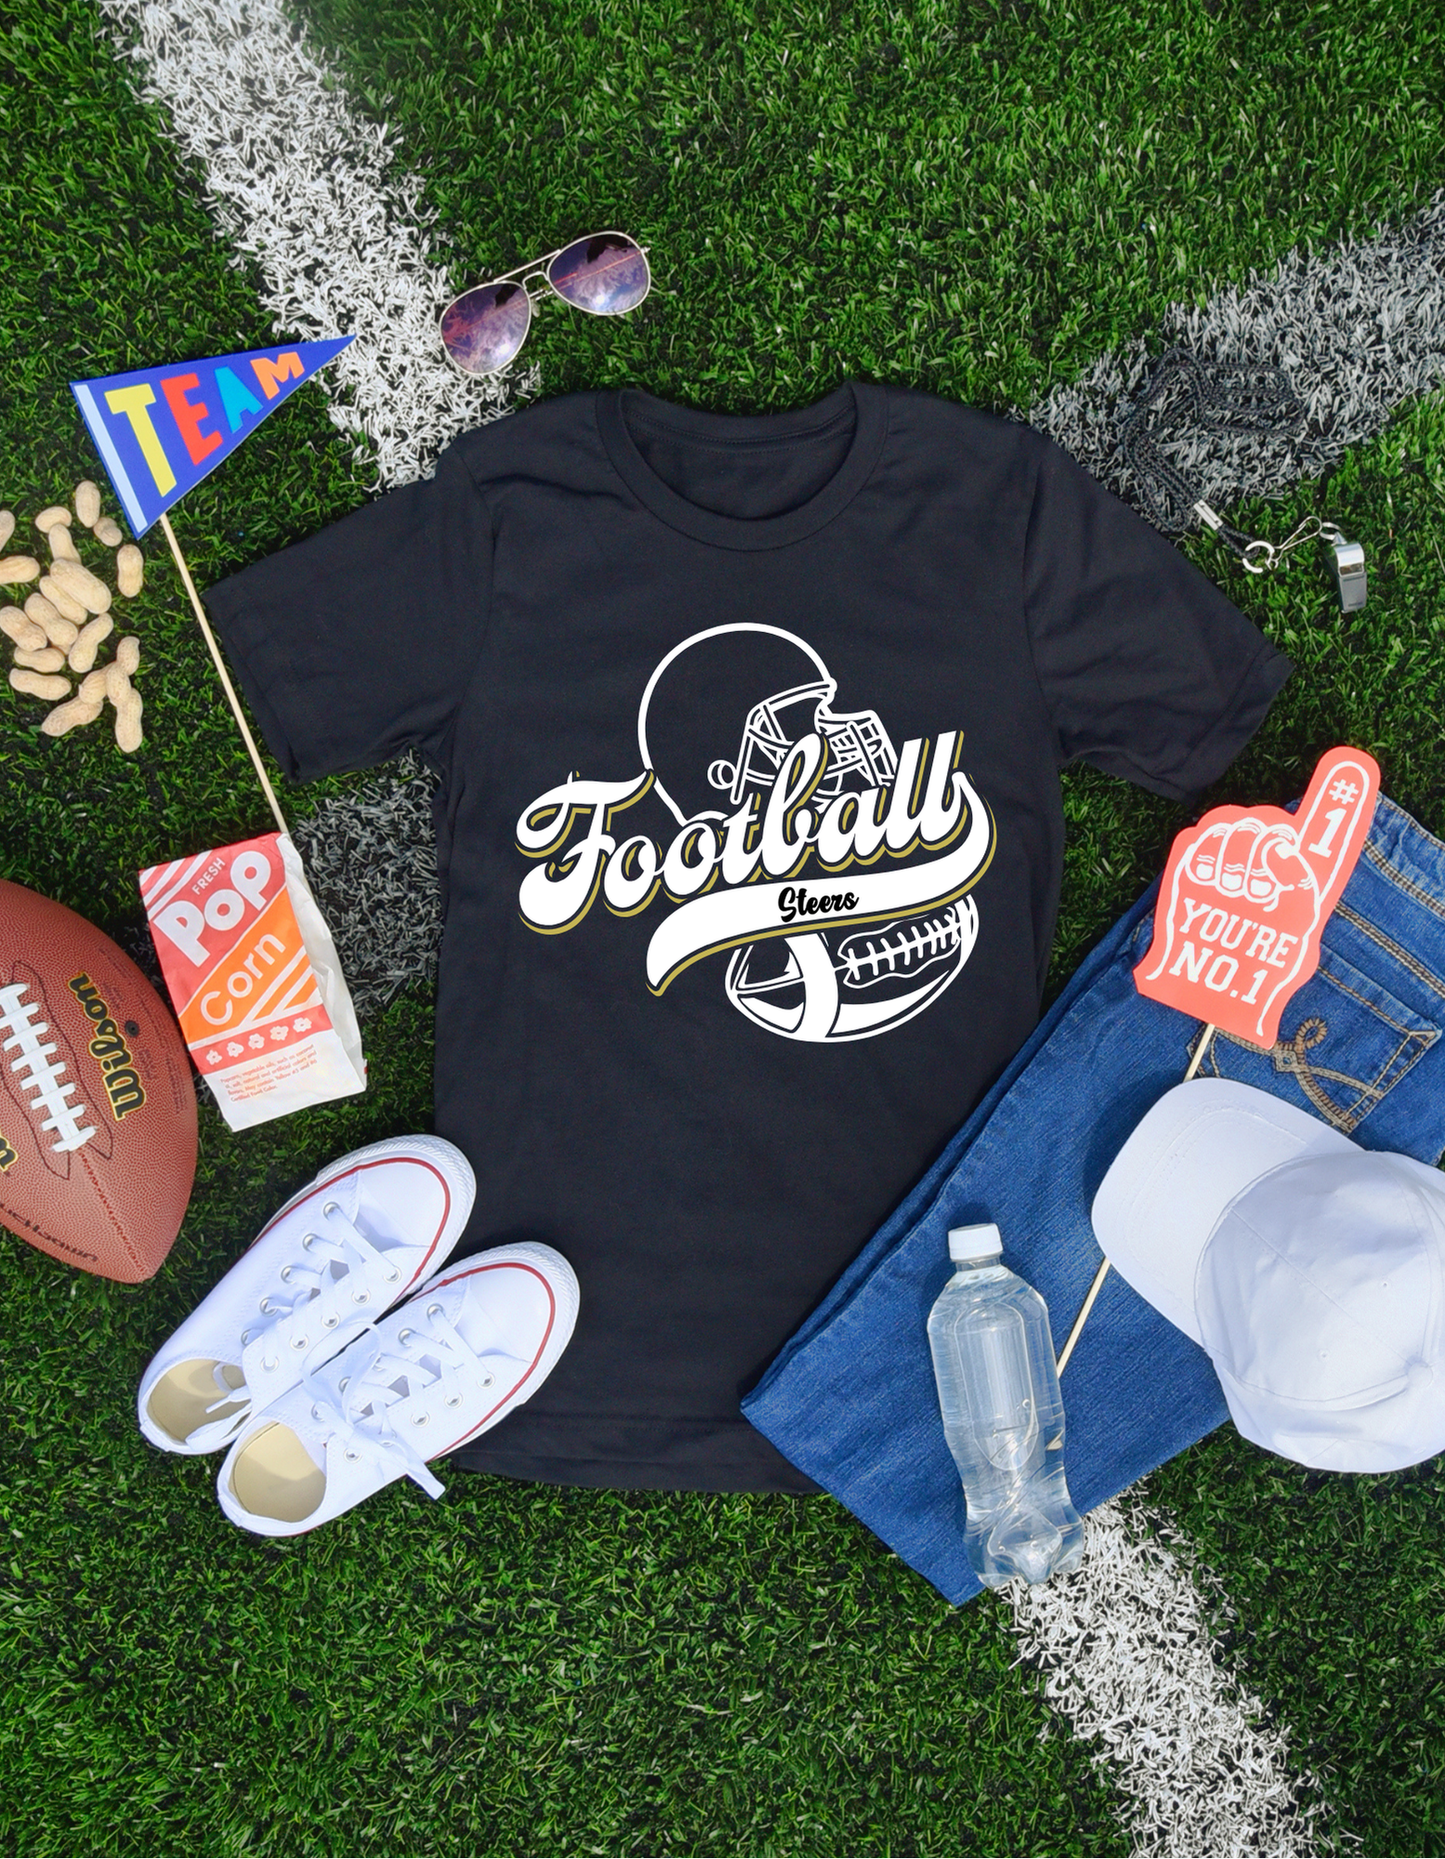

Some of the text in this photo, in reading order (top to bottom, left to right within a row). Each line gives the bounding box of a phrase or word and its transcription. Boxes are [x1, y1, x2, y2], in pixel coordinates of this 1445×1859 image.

[104, 351, 305, 498] TEAM
[515, 730, 968, 935] Football
[191, 857, 226, 895] FRESH
[778, 886, 860, 923] Steers
[1169, 941, 1269, 1005] NO.1
[1179, 897, 1298, 968] YOU'RE
[201, 934, 286, 1026] Corn
[67, 971, 147, 1122] Wilson
